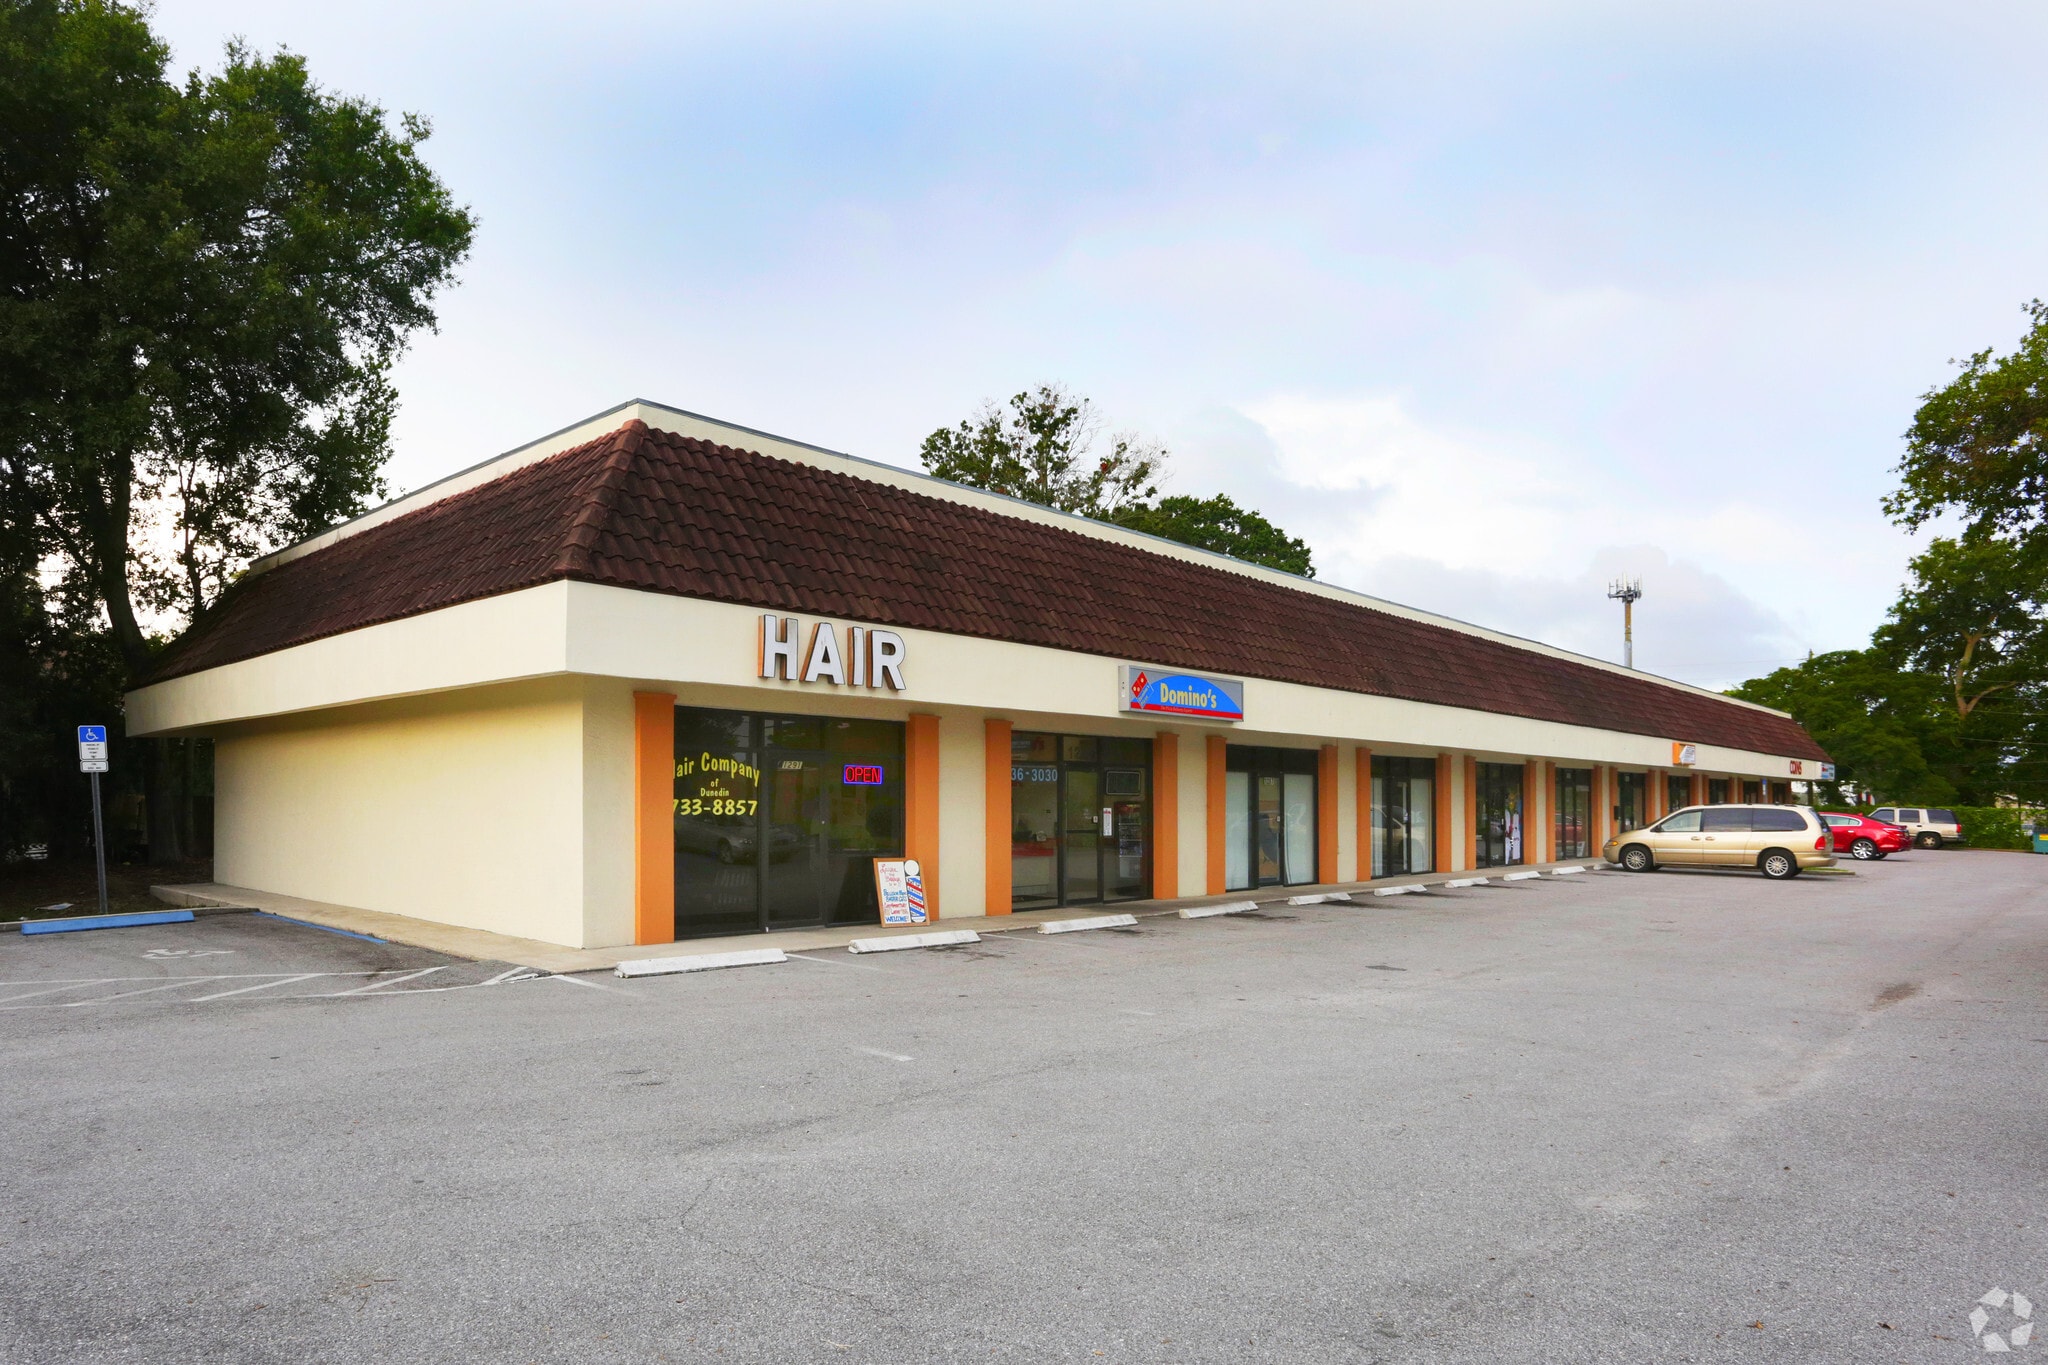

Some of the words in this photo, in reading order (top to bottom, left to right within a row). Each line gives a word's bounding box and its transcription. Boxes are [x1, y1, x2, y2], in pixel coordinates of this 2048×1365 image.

[757, 614, 906, 690] HAIR
[1160, 683, 1217, 708] Domino's
[701, 752, 760, 787] Company
[845, 766, 881, 783] OPEN
[700, 788, 730, 797] Dunedin
[710, 778, 723, 787] of
